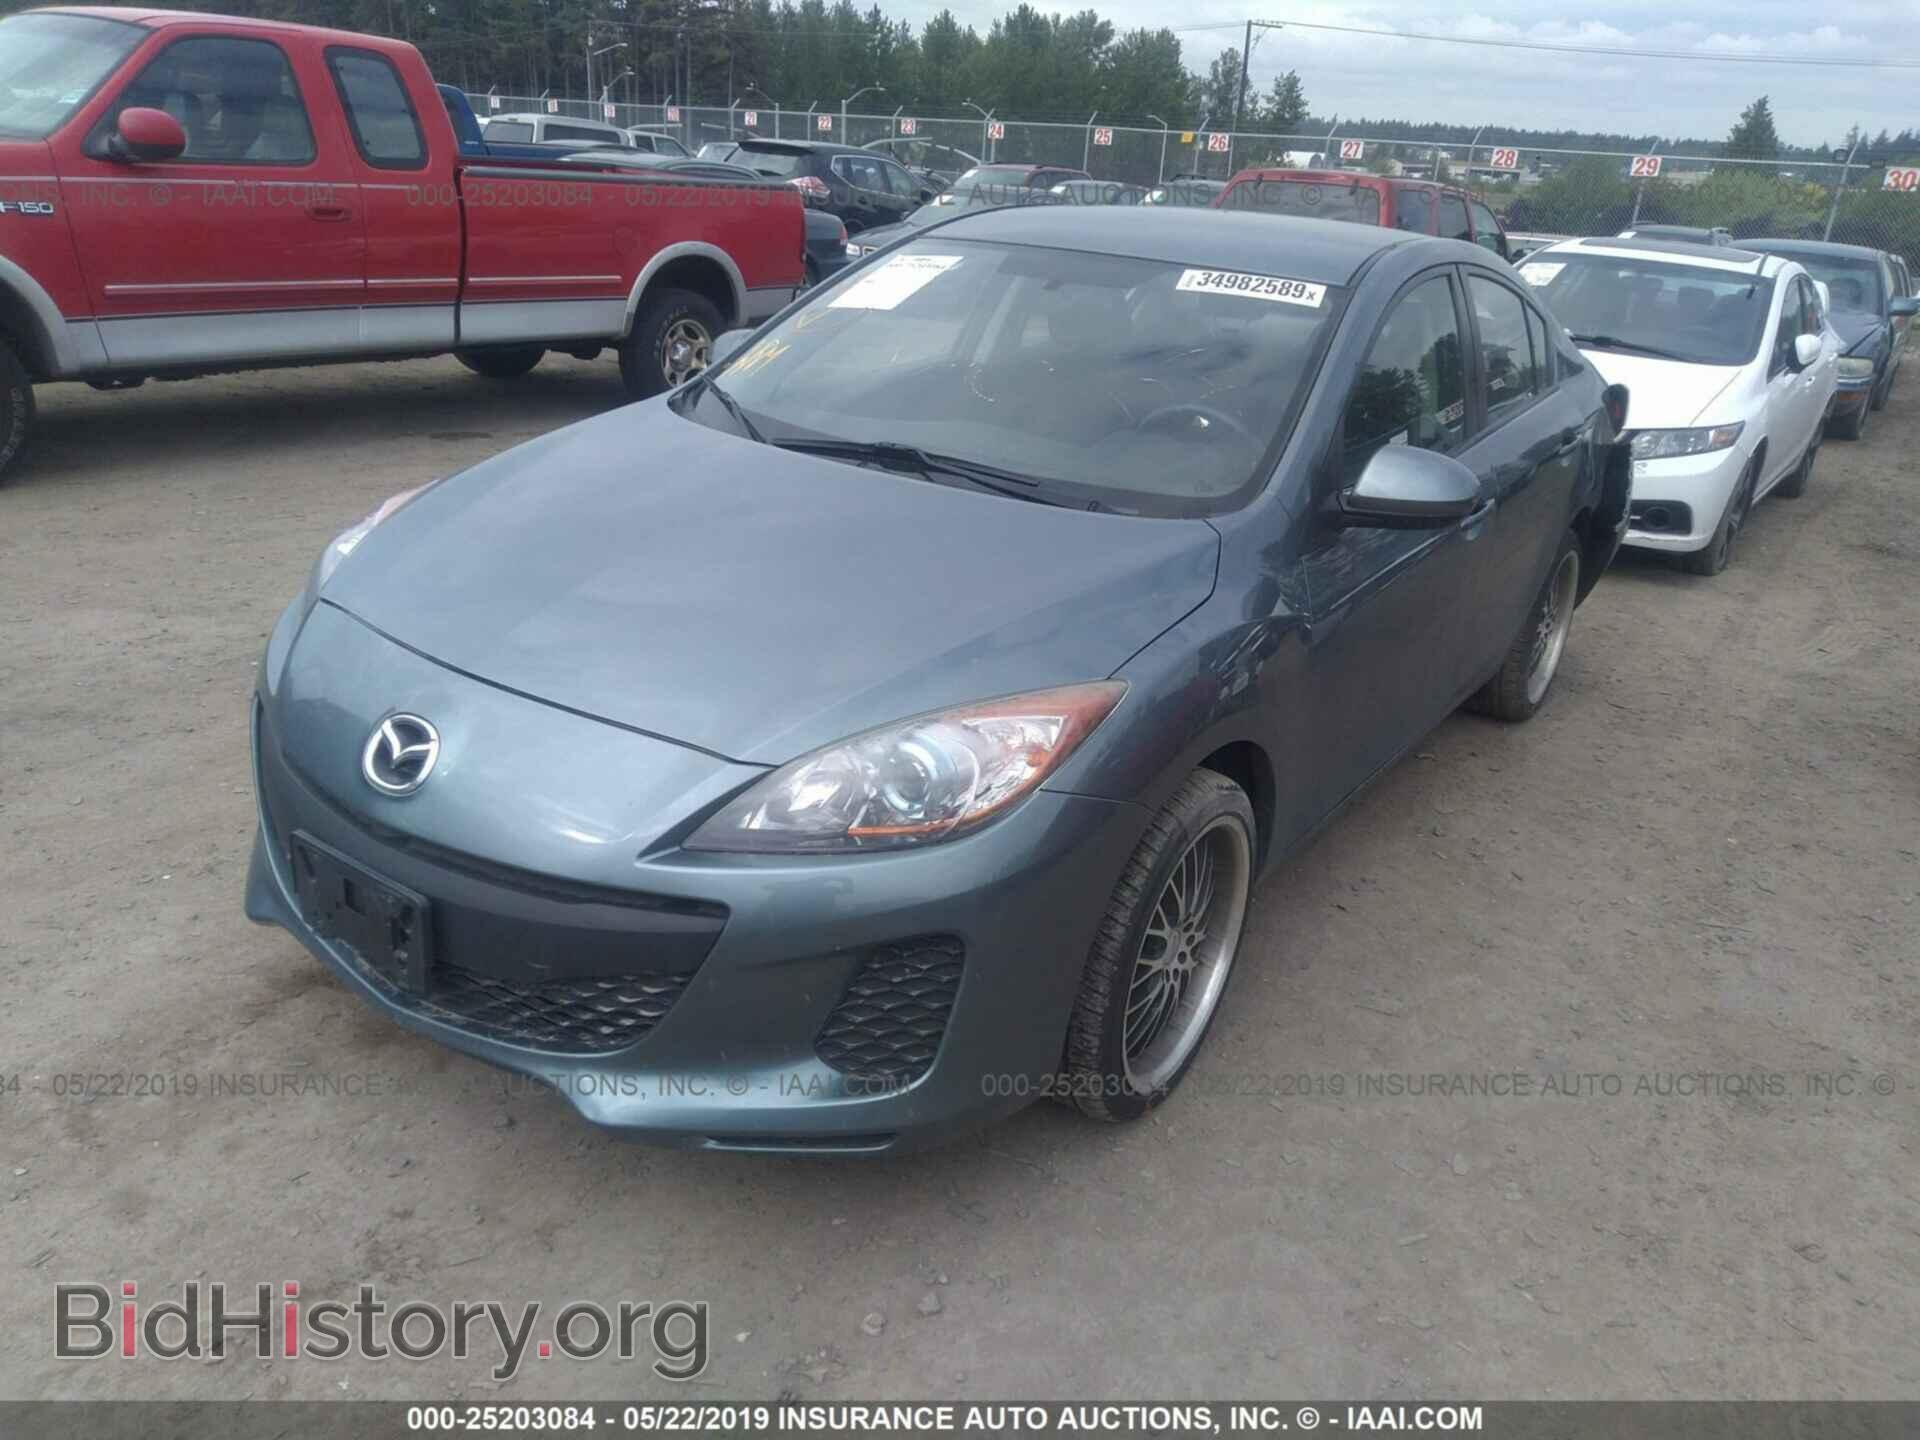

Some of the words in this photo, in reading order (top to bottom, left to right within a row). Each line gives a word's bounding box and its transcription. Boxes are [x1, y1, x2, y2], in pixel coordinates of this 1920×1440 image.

[819, 115, 831, 129] 22
[989, 123, 1003, 138] 24
[1096, 128, 1111, 144] 25
[1210, 133, 1227, 149] 26
[1343, 140, 1361, 157] 27
[1494, 149, 1516, 167] 28
[1632, 157, 1659, 176] 29
[1888, 169, 1918, 191] 30
